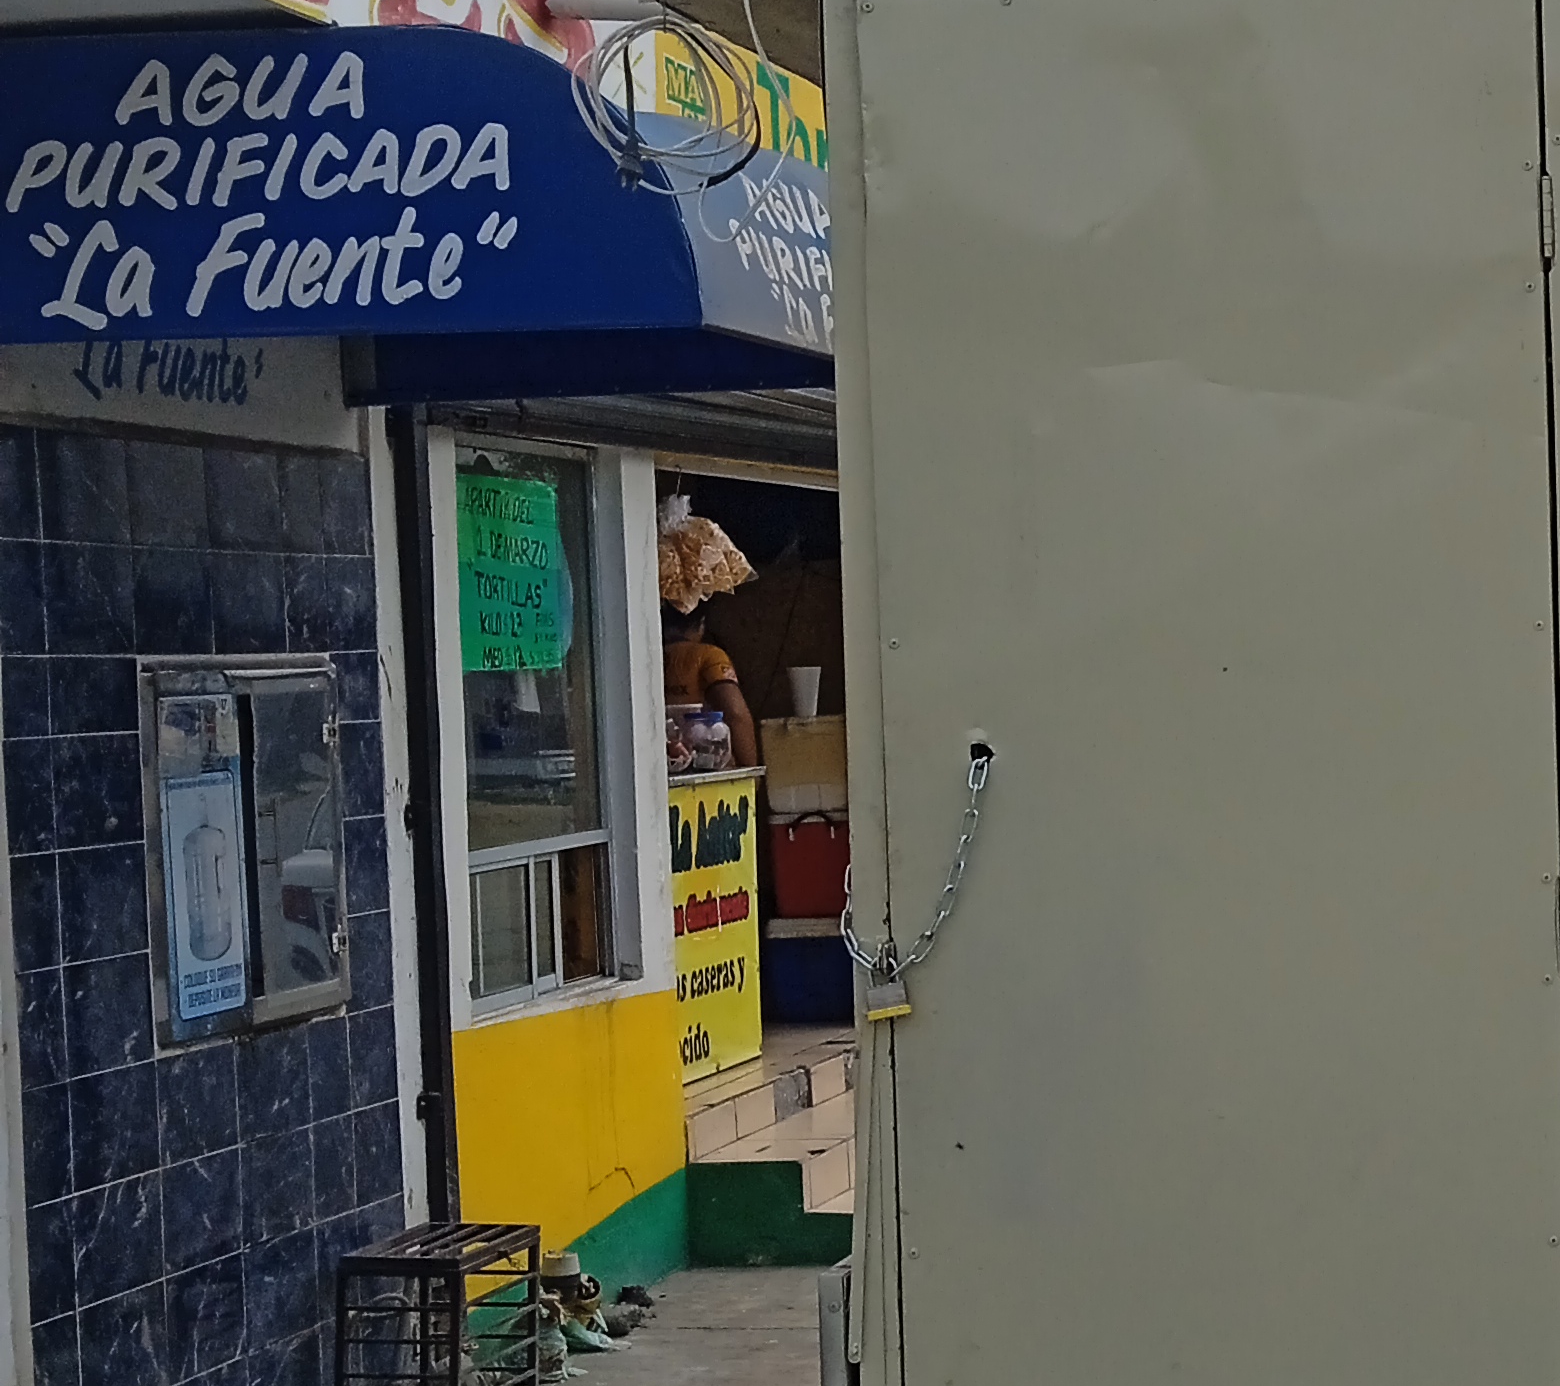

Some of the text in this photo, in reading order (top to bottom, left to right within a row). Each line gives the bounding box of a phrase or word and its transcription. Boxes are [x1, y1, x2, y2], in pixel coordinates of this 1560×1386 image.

[115, 51, 365, 126] AGUA
[5, 122, 511, 213] PURIFICADA
[690, 958, 736, 1000] caseras
[737, 956, 746, 994] y
